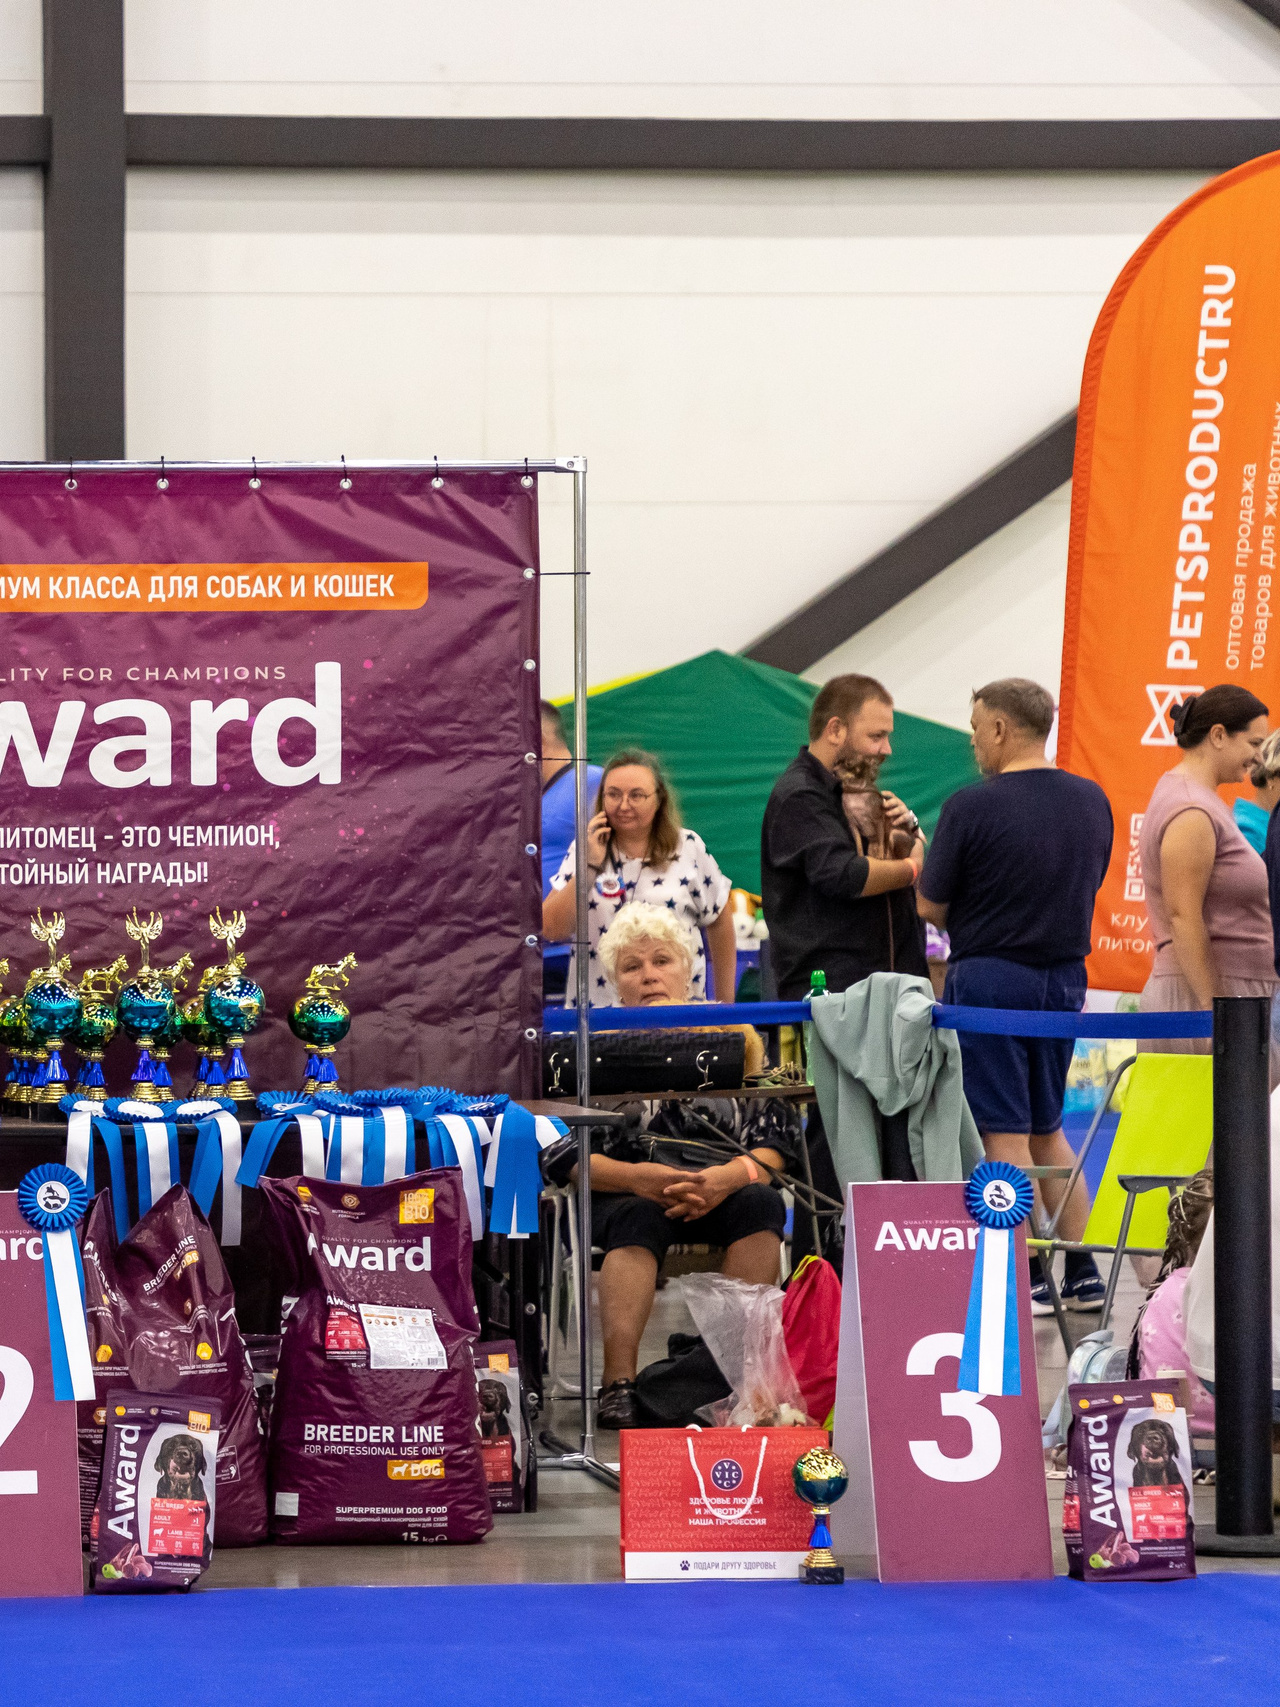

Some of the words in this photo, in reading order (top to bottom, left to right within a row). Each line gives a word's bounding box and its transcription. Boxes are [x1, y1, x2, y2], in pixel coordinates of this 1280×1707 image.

[1166, 264, 1236, 669] PETSPRODUCTRU
[1236, 463, 1257, 568] продажа
[1260, 524, 1276, 569] для
[49, 574, 141, 600] КЛАССА
[148, 575, 198, 602] ДЛЯ
[206, 574, 284, 599] СОБАК
[290, 574, 306, 598] И
[314, 573, 396, 598] КОШЕК
[1226, 574, 1247, 671] оптовая
[1251, 573, 1273, 671] товаров
[63, 666, 114, 682] FOR
[125, 665, 287, 682] CHAMPIONS
[121, 826, 161, 847] ЭТО
[168, 824, 281, 850] ЧЕМПИОН,
[96, 861, 209, 886] НАГРАДЫ!
[404, 1205, 430, 1221] BIO
[175, 1235, 196, 1255] LINE
[321, 1235, 351, 1243] QUALITY
[874, 1221, 980, 1251] Awar
[906, 1332, 1003, 1483] 3
[189, 1422, 207, 1433] BIO
[191, 1413, 209, 1423] 100%
[303, 1423, 395, 1443] BREEDER
[401, 1425, 444, 1443] LINE
[304, 1445, 322, 1454] FOR
[324, 1445, 396, 1456] PROFESSIONAL
[400, 1446, 419, 1456] USE
[421, 1446, 445, 1455] ONLY
[411, 1463, 441, 1477] DOG
[1081, 1414, 1117, 1528] Award
[107, 1424, 141, 1540] Award
[336, 1506, 404, 1514] SUPERPREMIUM
[425, 1506, 448, 1514] FOOD
[716, 1518, 767, 1526] ПРОФЕССИЯ
[402, 1531, 419, 1542] 15
[693, 1561, 719, 1570] ПОДАРИ
[721, 1562, 741, 1570] ДРУГУ
[743, 1561, 777, 1570] ЗДОРОВЬЕ
